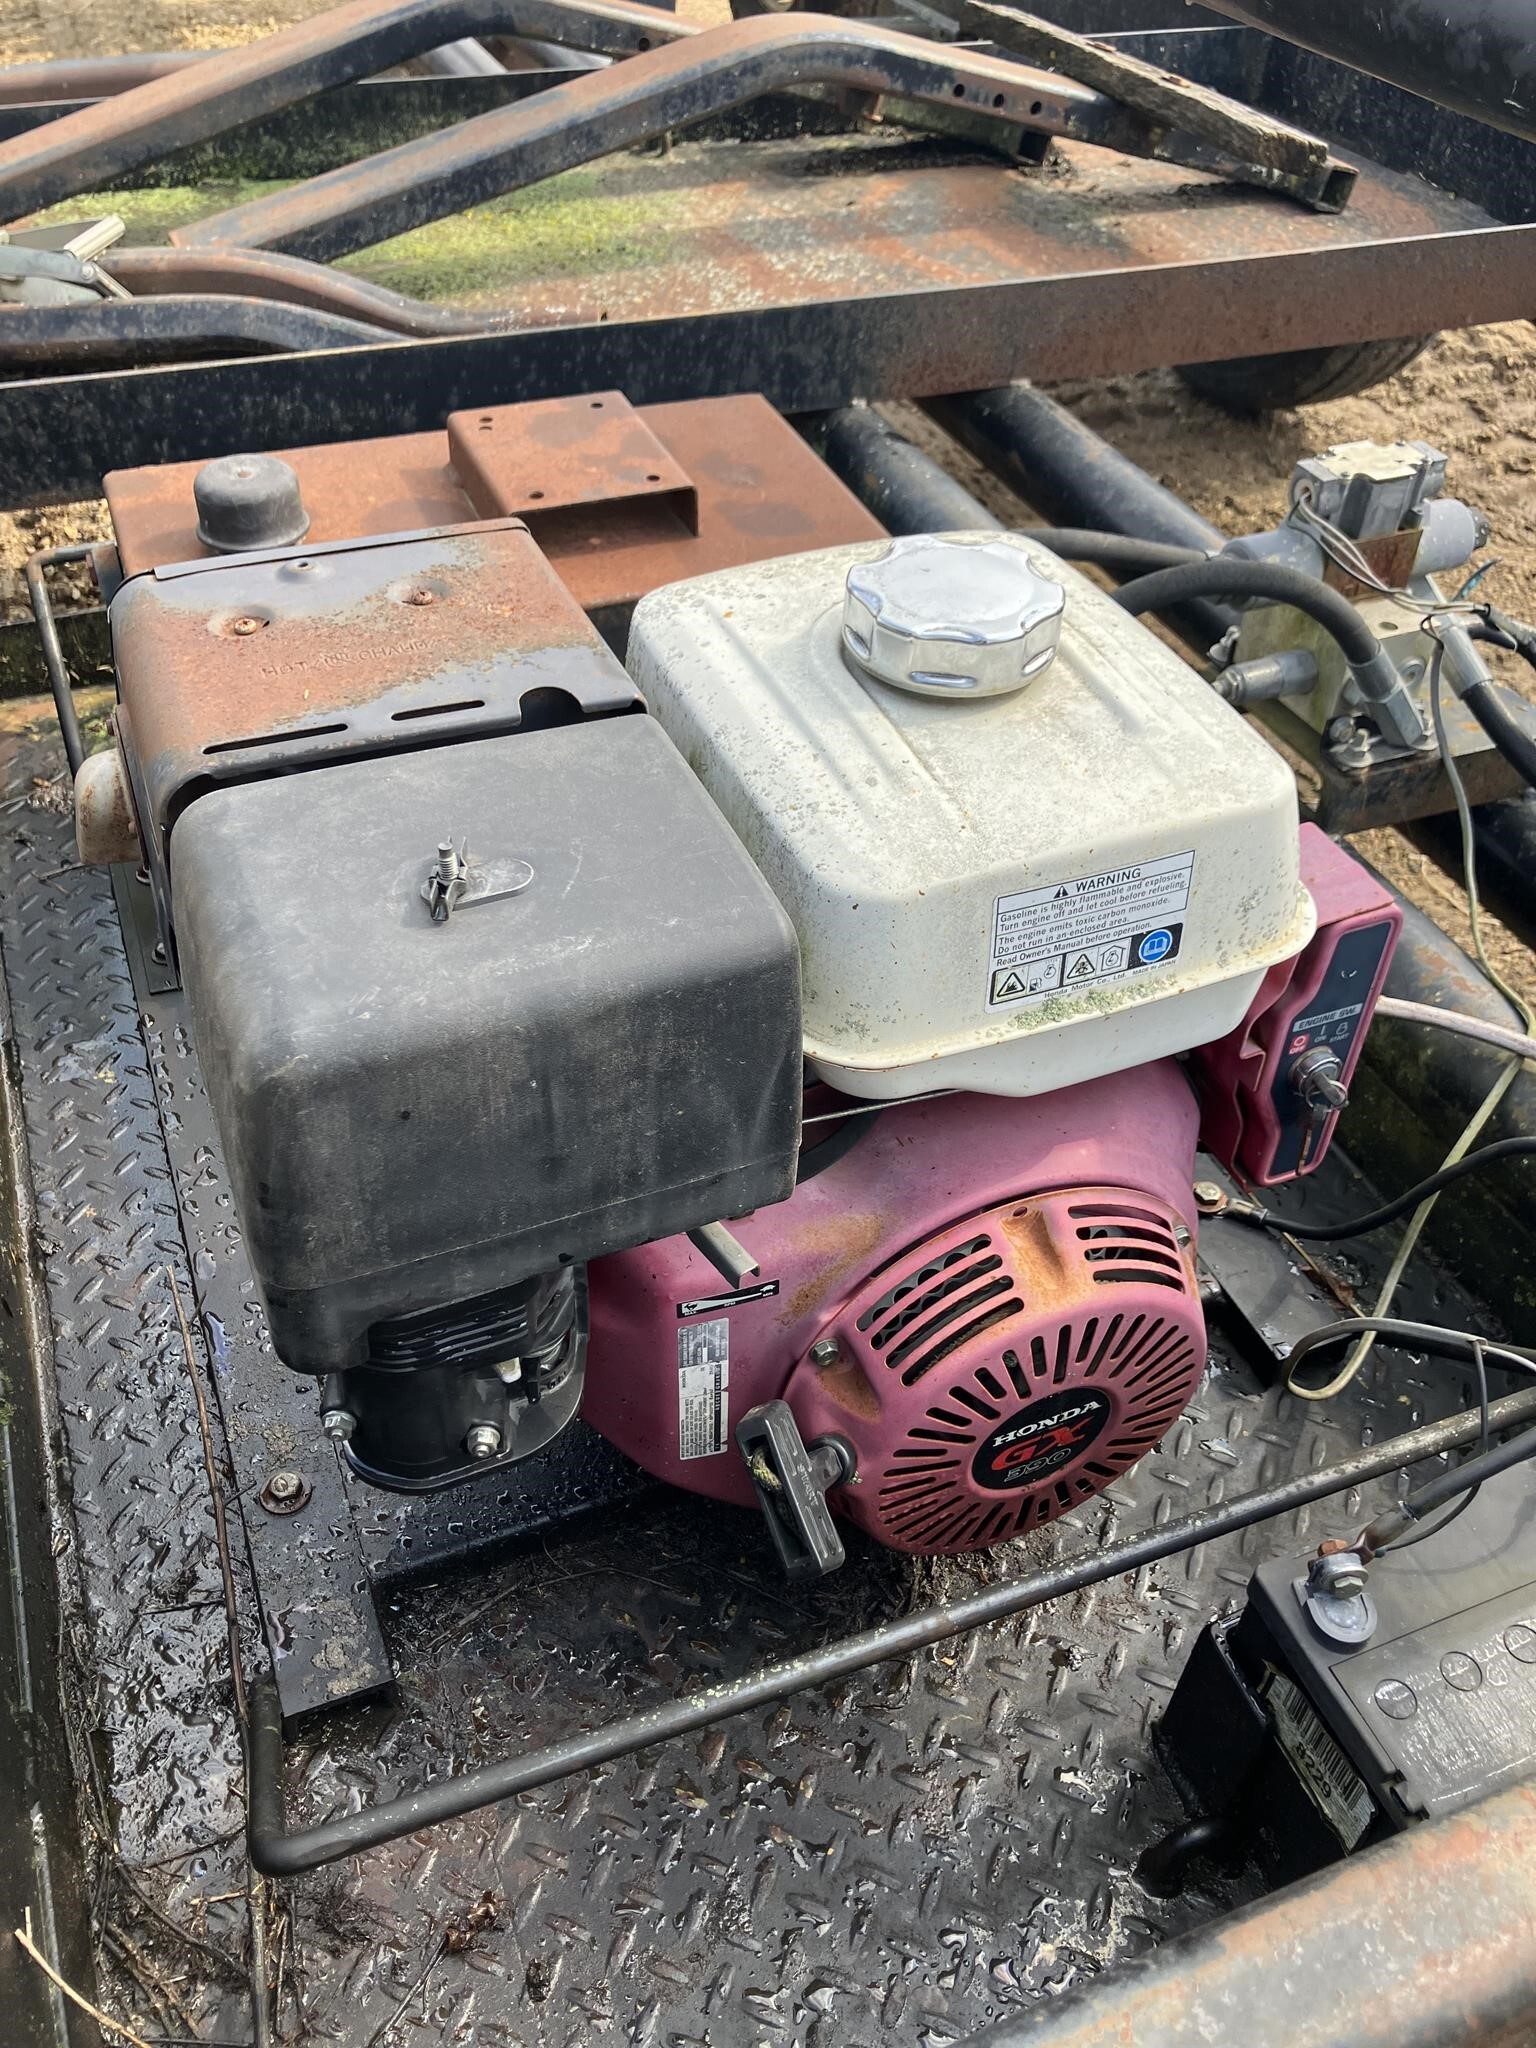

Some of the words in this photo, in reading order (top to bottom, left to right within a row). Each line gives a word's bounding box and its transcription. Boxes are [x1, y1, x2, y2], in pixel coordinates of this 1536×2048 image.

[1000, 908, 1037, 922] Gasoline
[1050, 898, 1076, 911] highly
[1079, 887, 1124, 903] flammable
[1126, 880, 1142, 892] and
[1144, 872, 1184, 887] explosive.
[1076, 867, 1140, 892] WARNING
[999, 922, 1018, 931] Turn
[1021, 914, 1050, 927] engine
[1053, 909, 1065, 919] off
[1067, 904, 1083, 915] and
[1086, 901, 1097, 911] let
[1099, 896, 1117, 907] cool
[1119, 890, 1146, 902] before
[1148, 880, 1187, 895] refueling.
[999, 936, 1015, 945] The
[1017, 928, 1046, 940] engine
[1049, 921, 1072, 932] emits
[1075, 915, 1095, 926] toxic
[1097, 908, 1126, 920] carbon
[1128, 897, 1170, 912] monoxide.
[996, 954, 1017, 966] Read
[1019, 946, 1051, 960] Owner's
[1053, 937, 1083, 952] Manual
[1085, 932, 1110, 944] before
[1112, 921, 1151, 937] operation.
[997, 946, 1009, 954] Do
[1012, 941, 1026, 951] not
[1028, 938, 1042, 947] run
[1055, 932, 1066, 940] an
[1069, 920, 1106, 936] enclosed
[1108, 916, 1129, 926] area.
[1044, 988, 1068, 998] Honda
[1070, 981, 1094, 991] Motor
[1112, 972, 1127, 980] Ltd.
[1298, 1014, 1336, 1028] ENGINE
[1314, 1035, 1326, 1043] ON
[991, 1415, 1094, 1470] GX
[993, 1400, 1103, 1447] HONDA
[1003, 1447, 1072, 1482] 390
[1295, 1742, 1332, 1799] 8229
